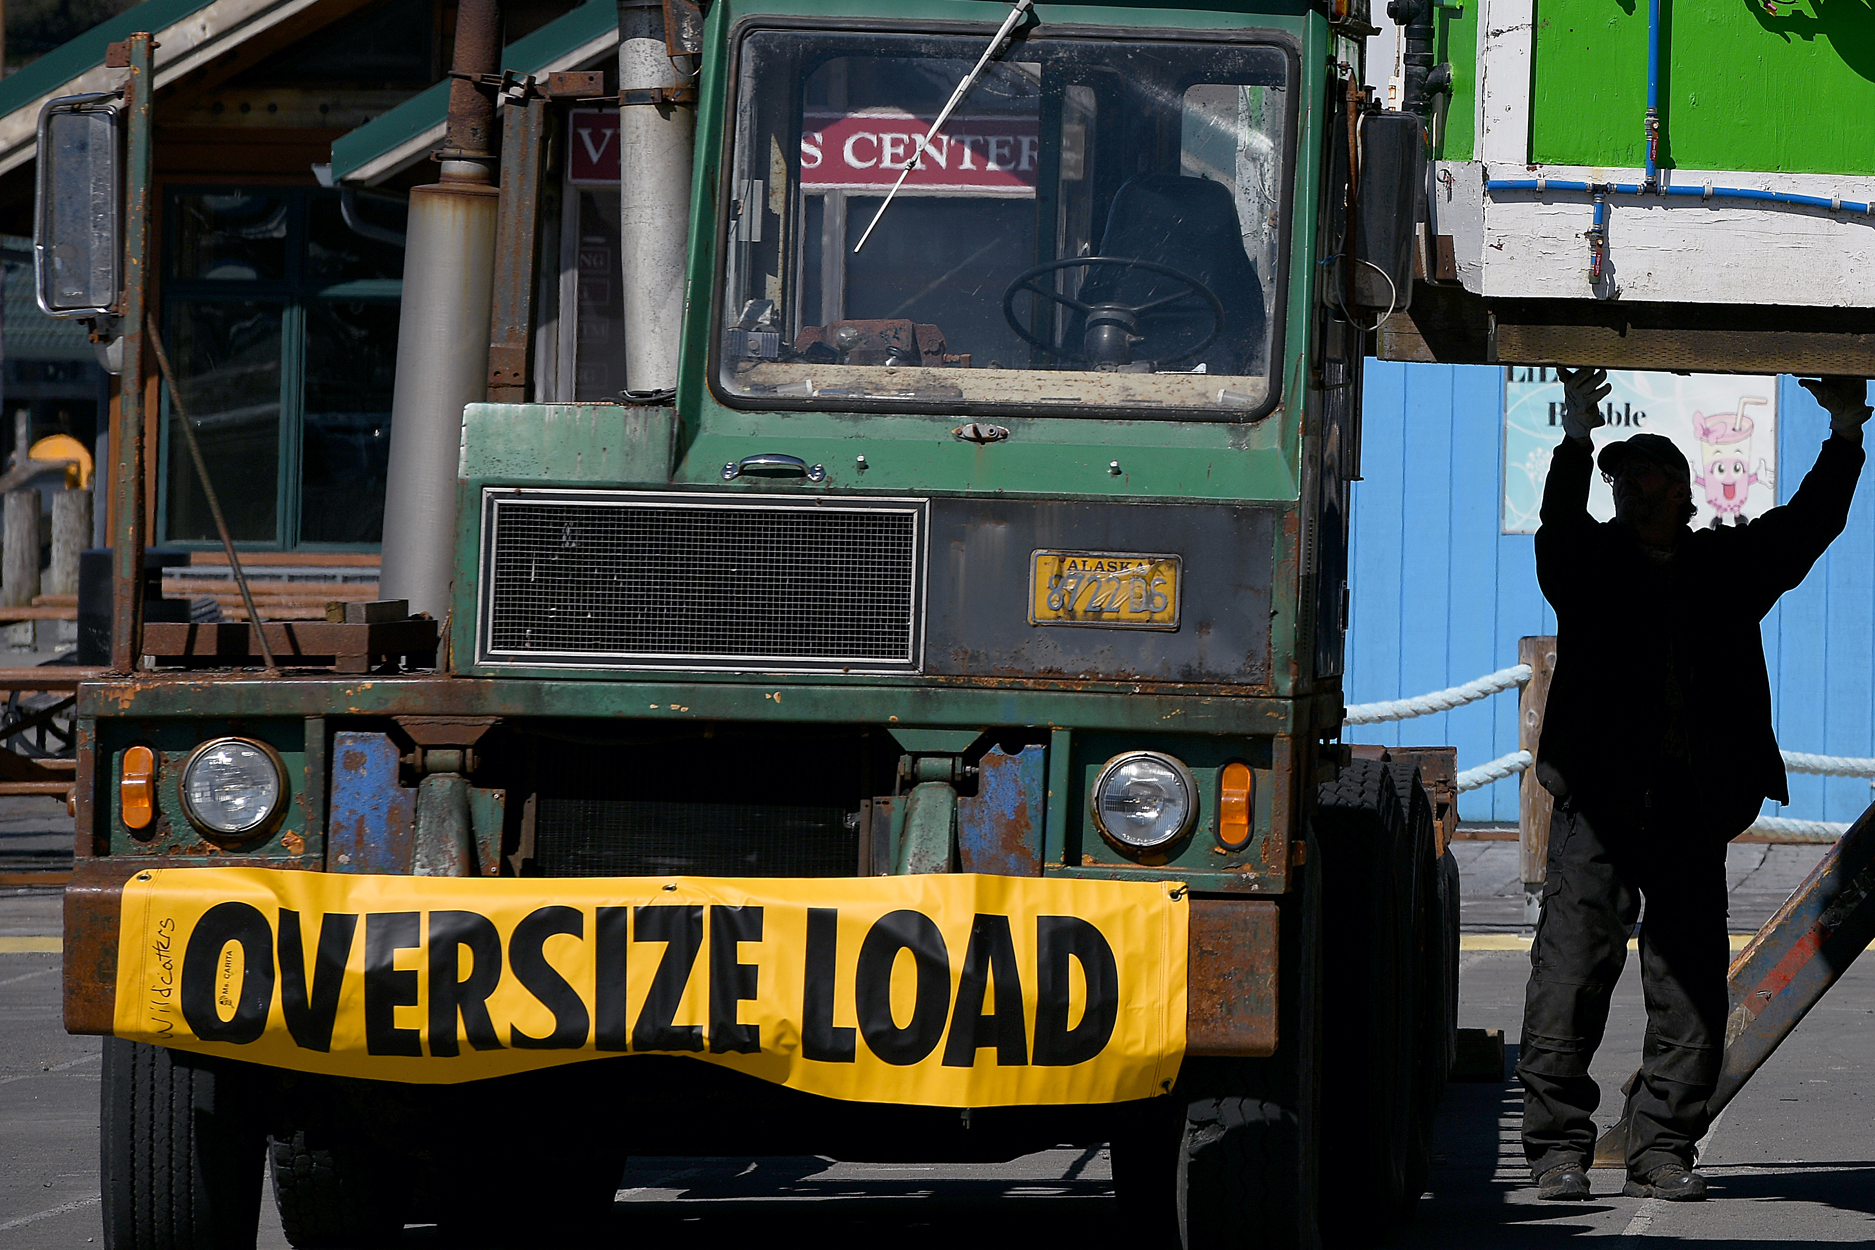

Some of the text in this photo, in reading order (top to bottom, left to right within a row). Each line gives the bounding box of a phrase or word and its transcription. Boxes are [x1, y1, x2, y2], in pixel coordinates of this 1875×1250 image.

[1547, 402, 1647, 428] Bble
[1067, 559, 1145, 573] ALASKA
[181, 901, 1119, 1067] OVERSIZE LOAD
